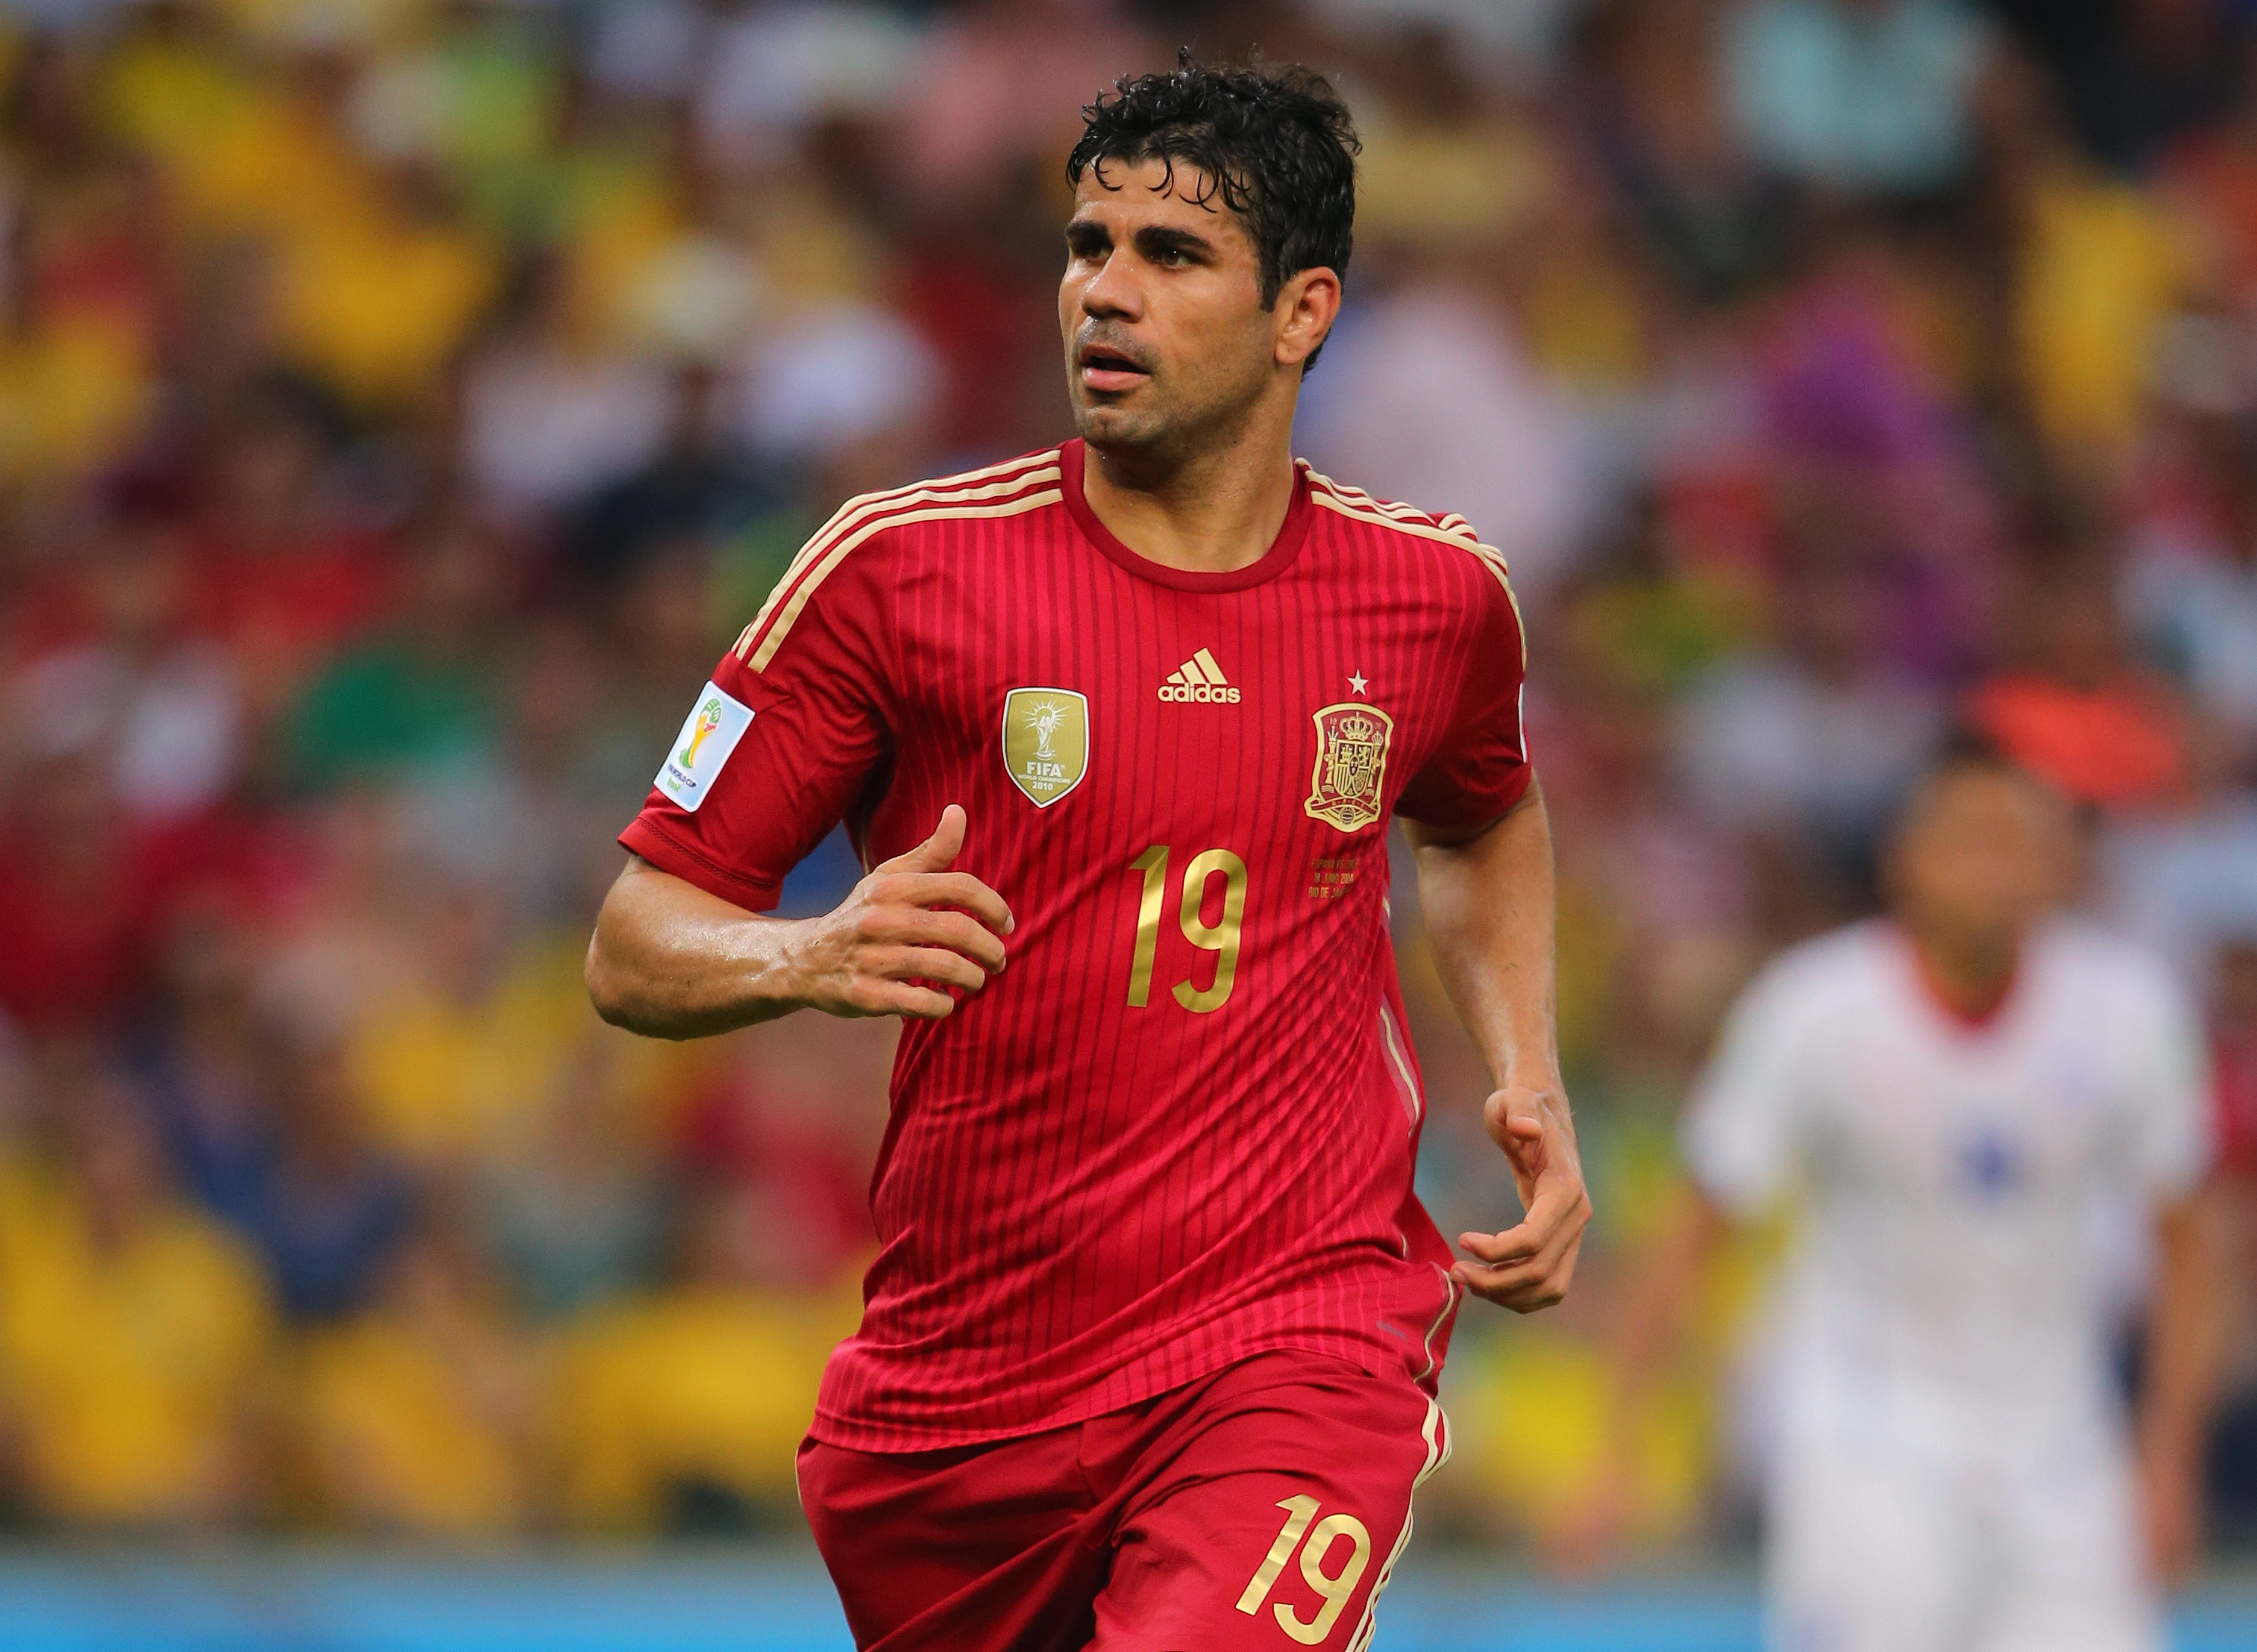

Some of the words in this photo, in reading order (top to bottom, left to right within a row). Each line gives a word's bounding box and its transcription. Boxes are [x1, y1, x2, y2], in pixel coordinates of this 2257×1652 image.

[1157, 682, 1241, 704] adidas
[1027, 761, 1062, 778] FIFA
[1032, 781, 1054, 791] 2010
[1127, 845, 1247, 1014] 19
[1235, 1494, 1371, 1645] 19
